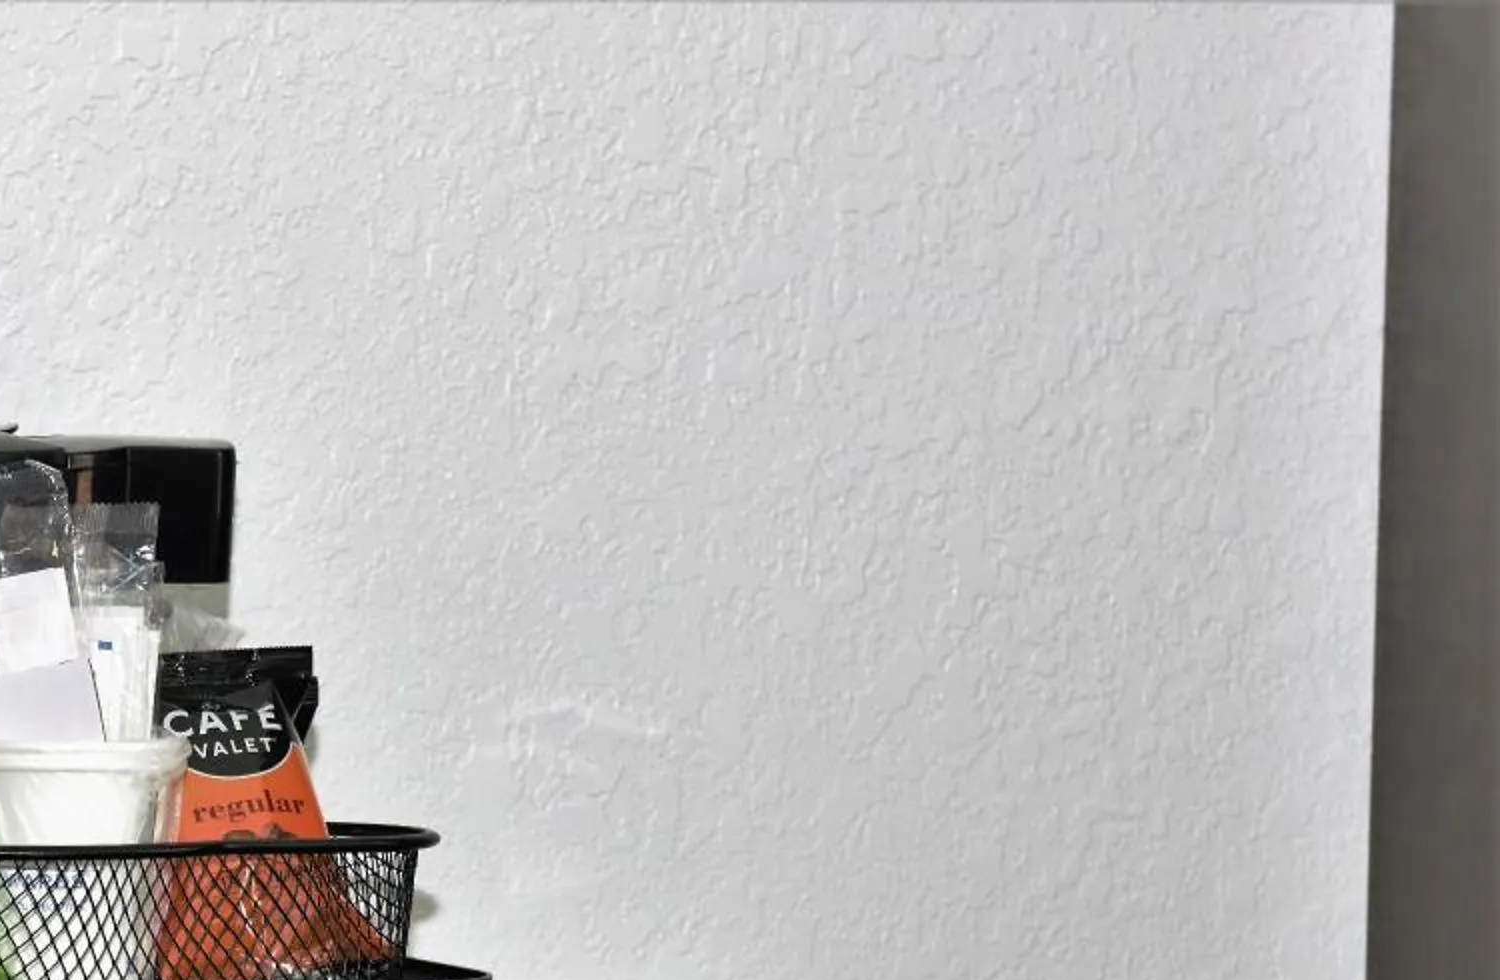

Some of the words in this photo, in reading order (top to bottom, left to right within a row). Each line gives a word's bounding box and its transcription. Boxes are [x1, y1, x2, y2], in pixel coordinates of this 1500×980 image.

[163, 703, 283, 738] CAFE
[194, 735, 276, 759] VALET
[192, 789, 306, 824] regular
